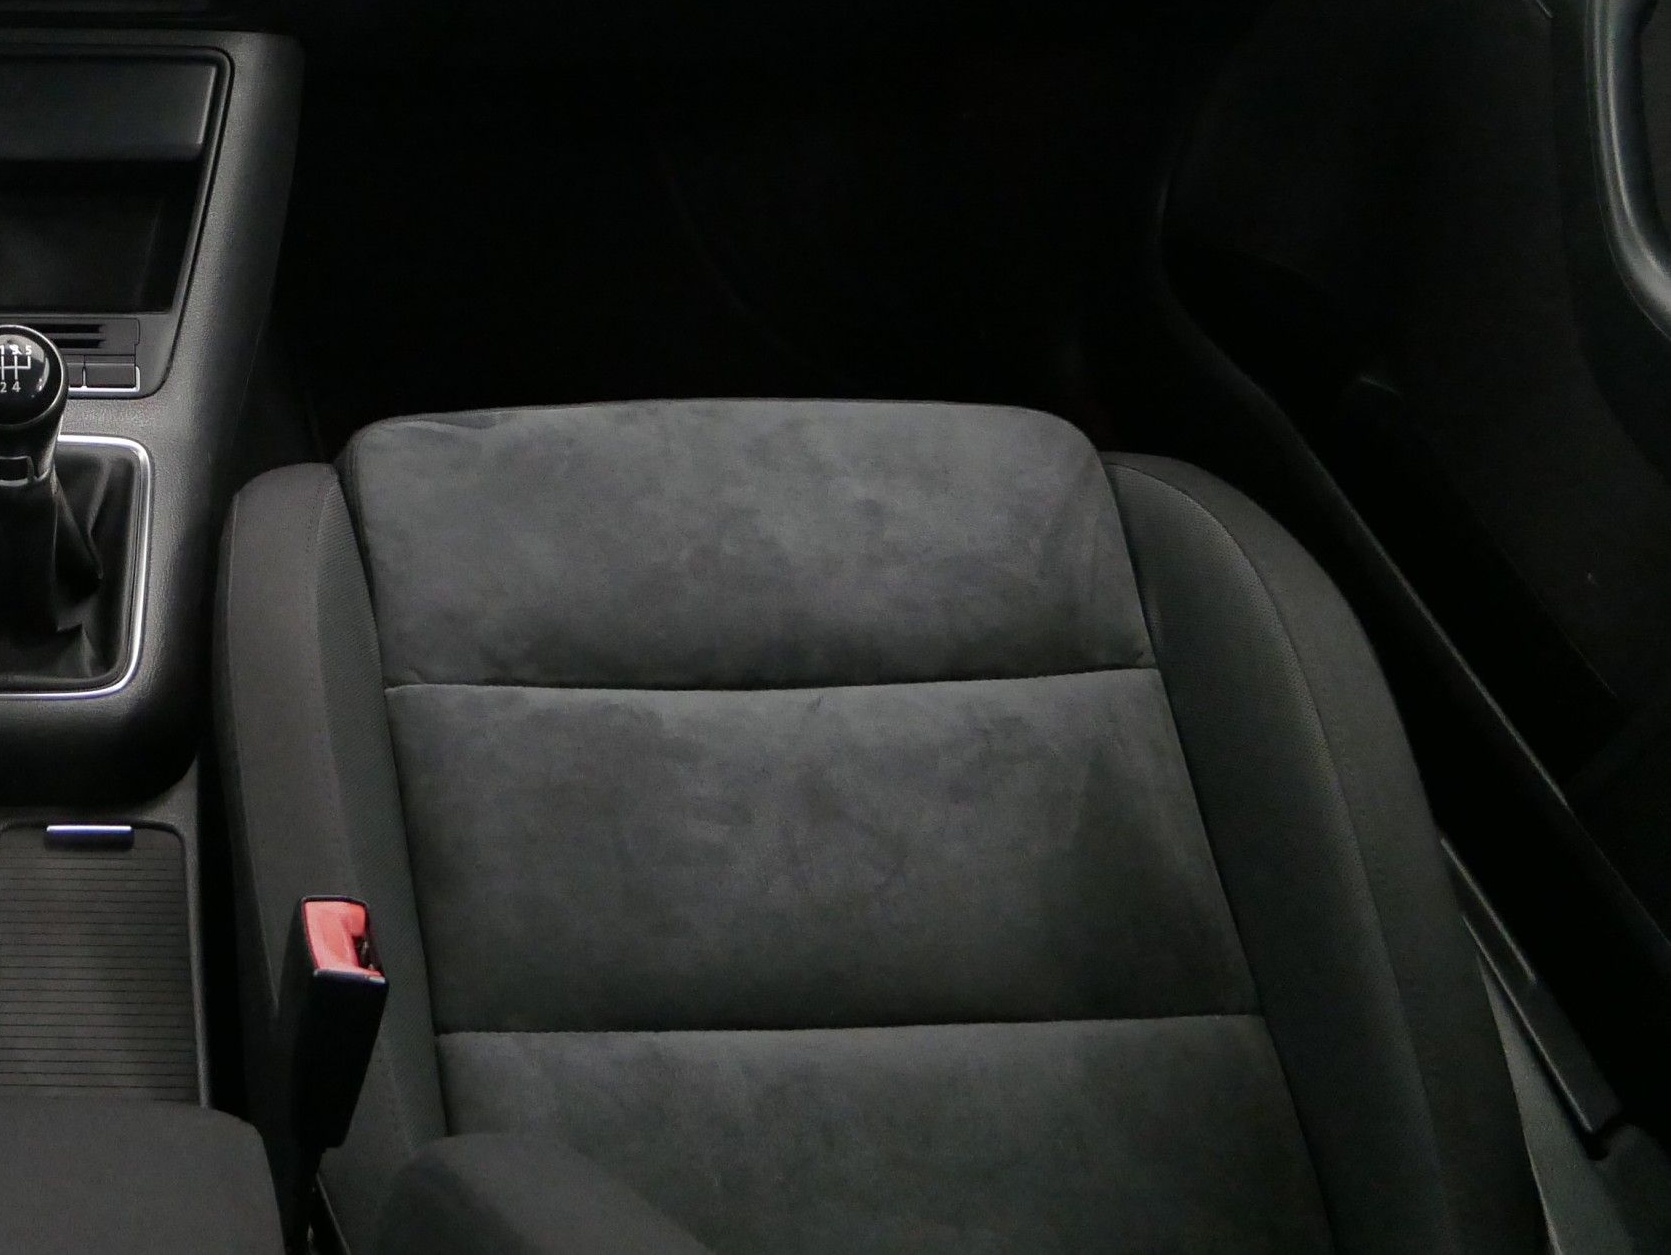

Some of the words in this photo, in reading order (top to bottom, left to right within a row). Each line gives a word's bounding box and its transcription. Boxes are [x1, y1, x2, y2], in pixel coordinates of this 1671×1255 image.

[0, 345, 5, 355] 1
[26, 345, 32, 355] 5
[0, 381, 7, 393] 2
[12, 381, 21, 393] 4
